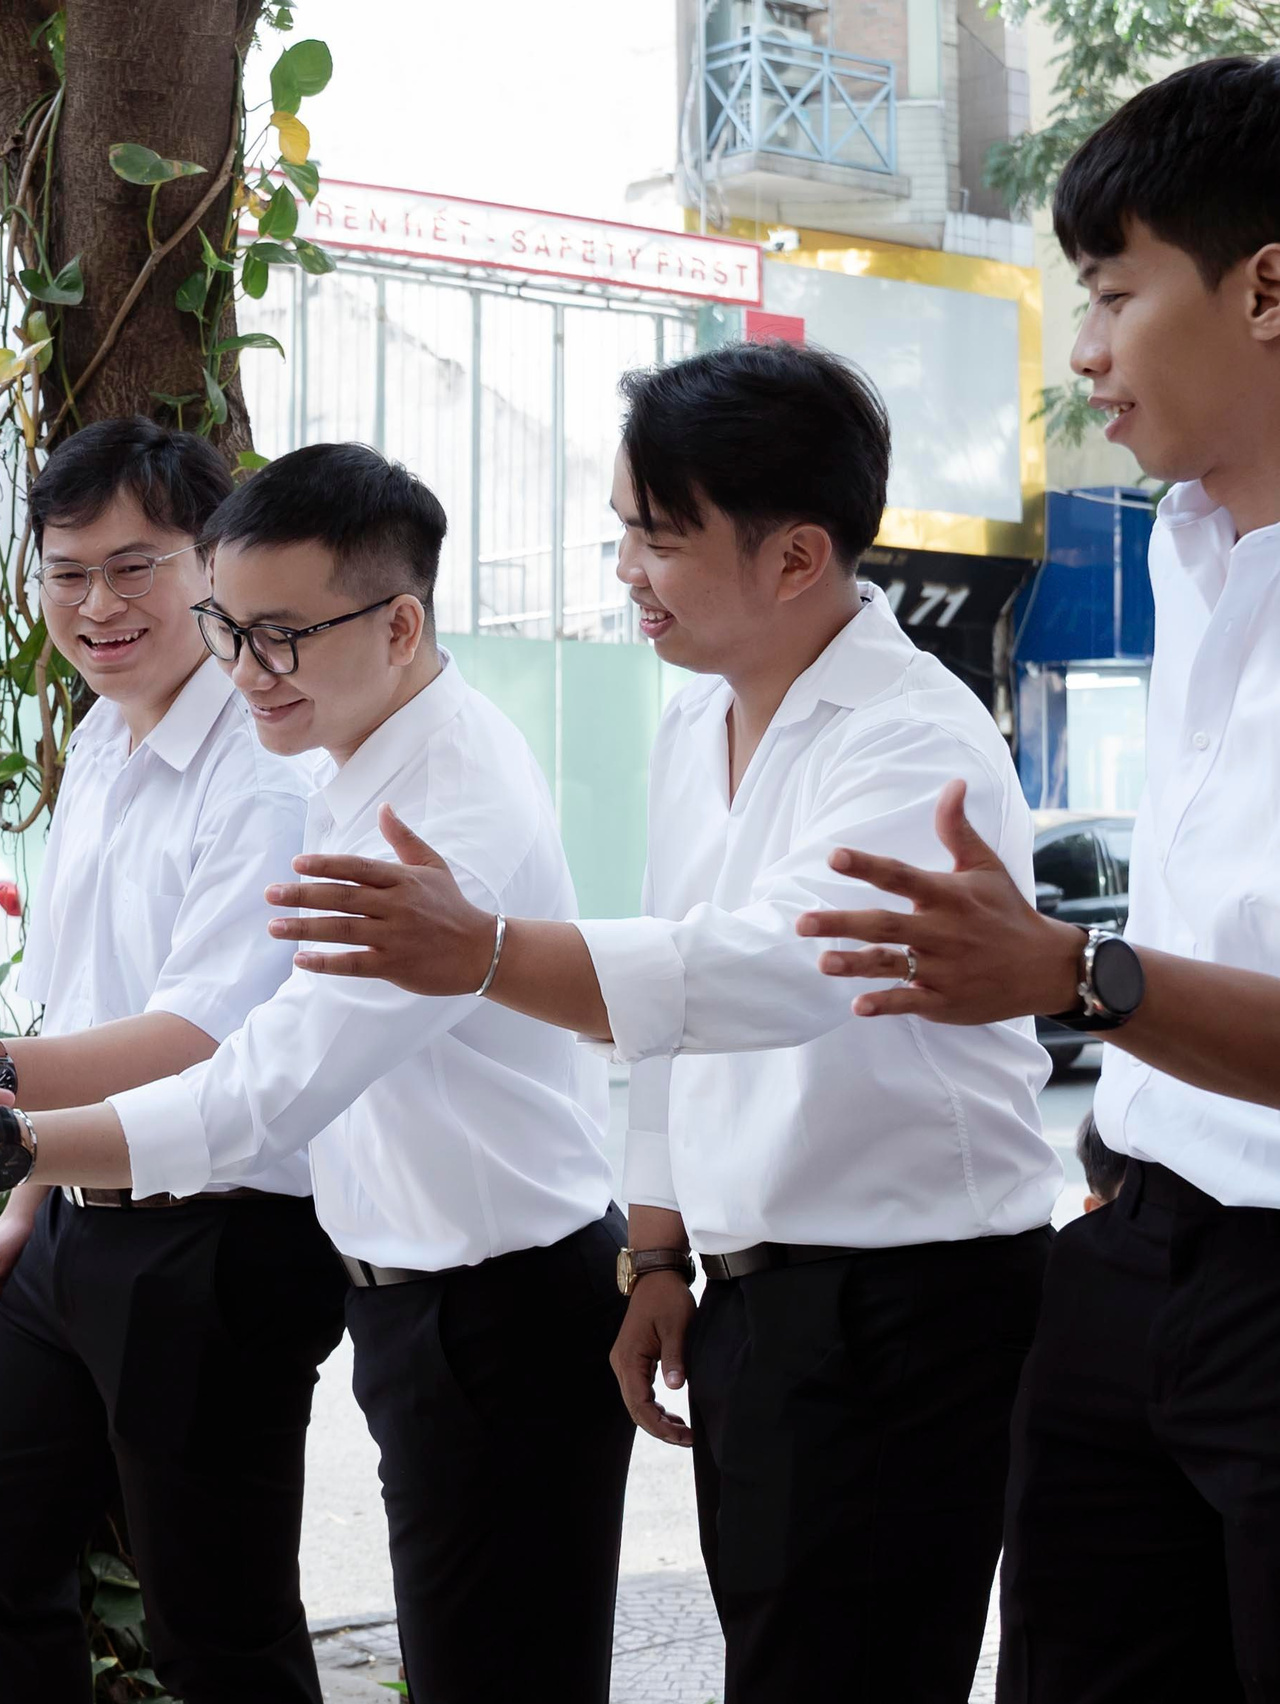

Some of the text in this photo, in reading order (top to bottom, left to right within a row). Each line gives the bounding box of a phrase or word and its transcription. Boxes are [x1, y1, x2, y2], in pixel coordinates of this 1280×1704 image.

[511, 229, 641, 270] SAFETY
[658, 251, 748, 286] FIRST
[907, 582, 970, 628] 71
